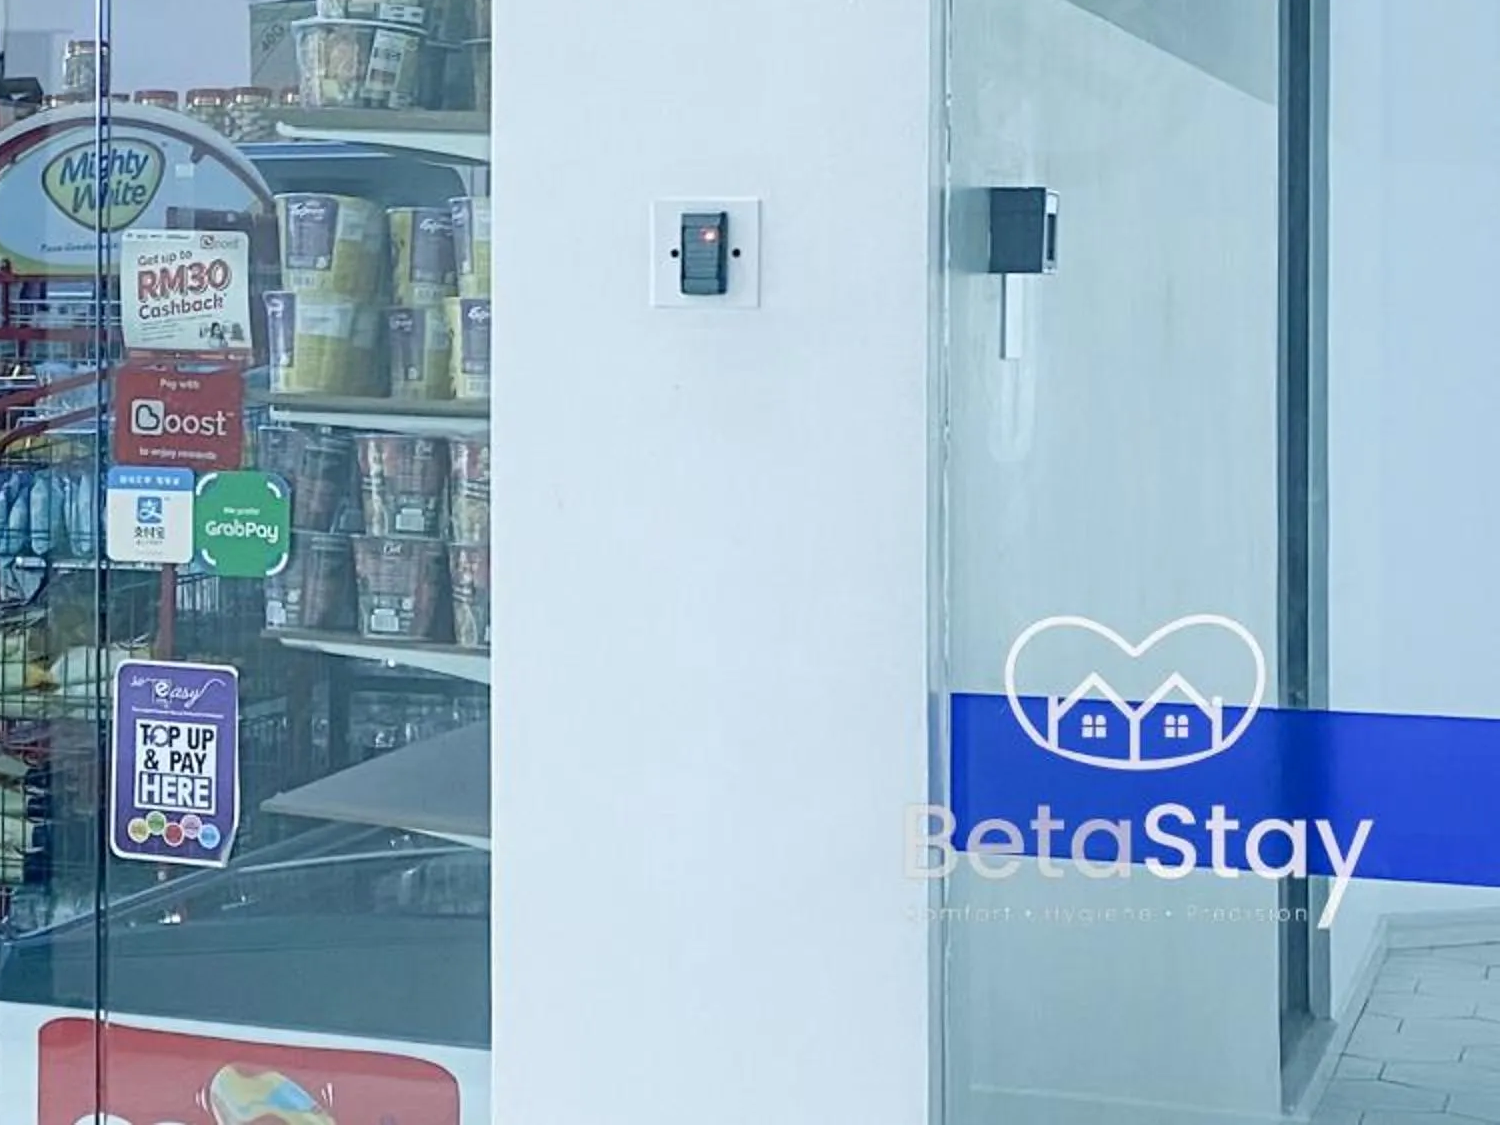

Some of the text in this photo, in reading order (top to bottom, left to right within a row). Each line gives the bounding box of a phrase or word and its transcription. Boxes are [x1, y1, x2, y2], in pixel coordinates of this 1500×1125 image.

[137, 250, 193, 266] Get up to
[137, 258, 232, 303] RM30
[139, 293, 224, 320] Cashback
[159, 378, 177, 390] Pay
[204, 519, 279, 544] GrabPay
[139, 723, 215, 751] TOP UP
[143, 748, 207, 774] & PAY
[141, 773, 210, 809] HERE
